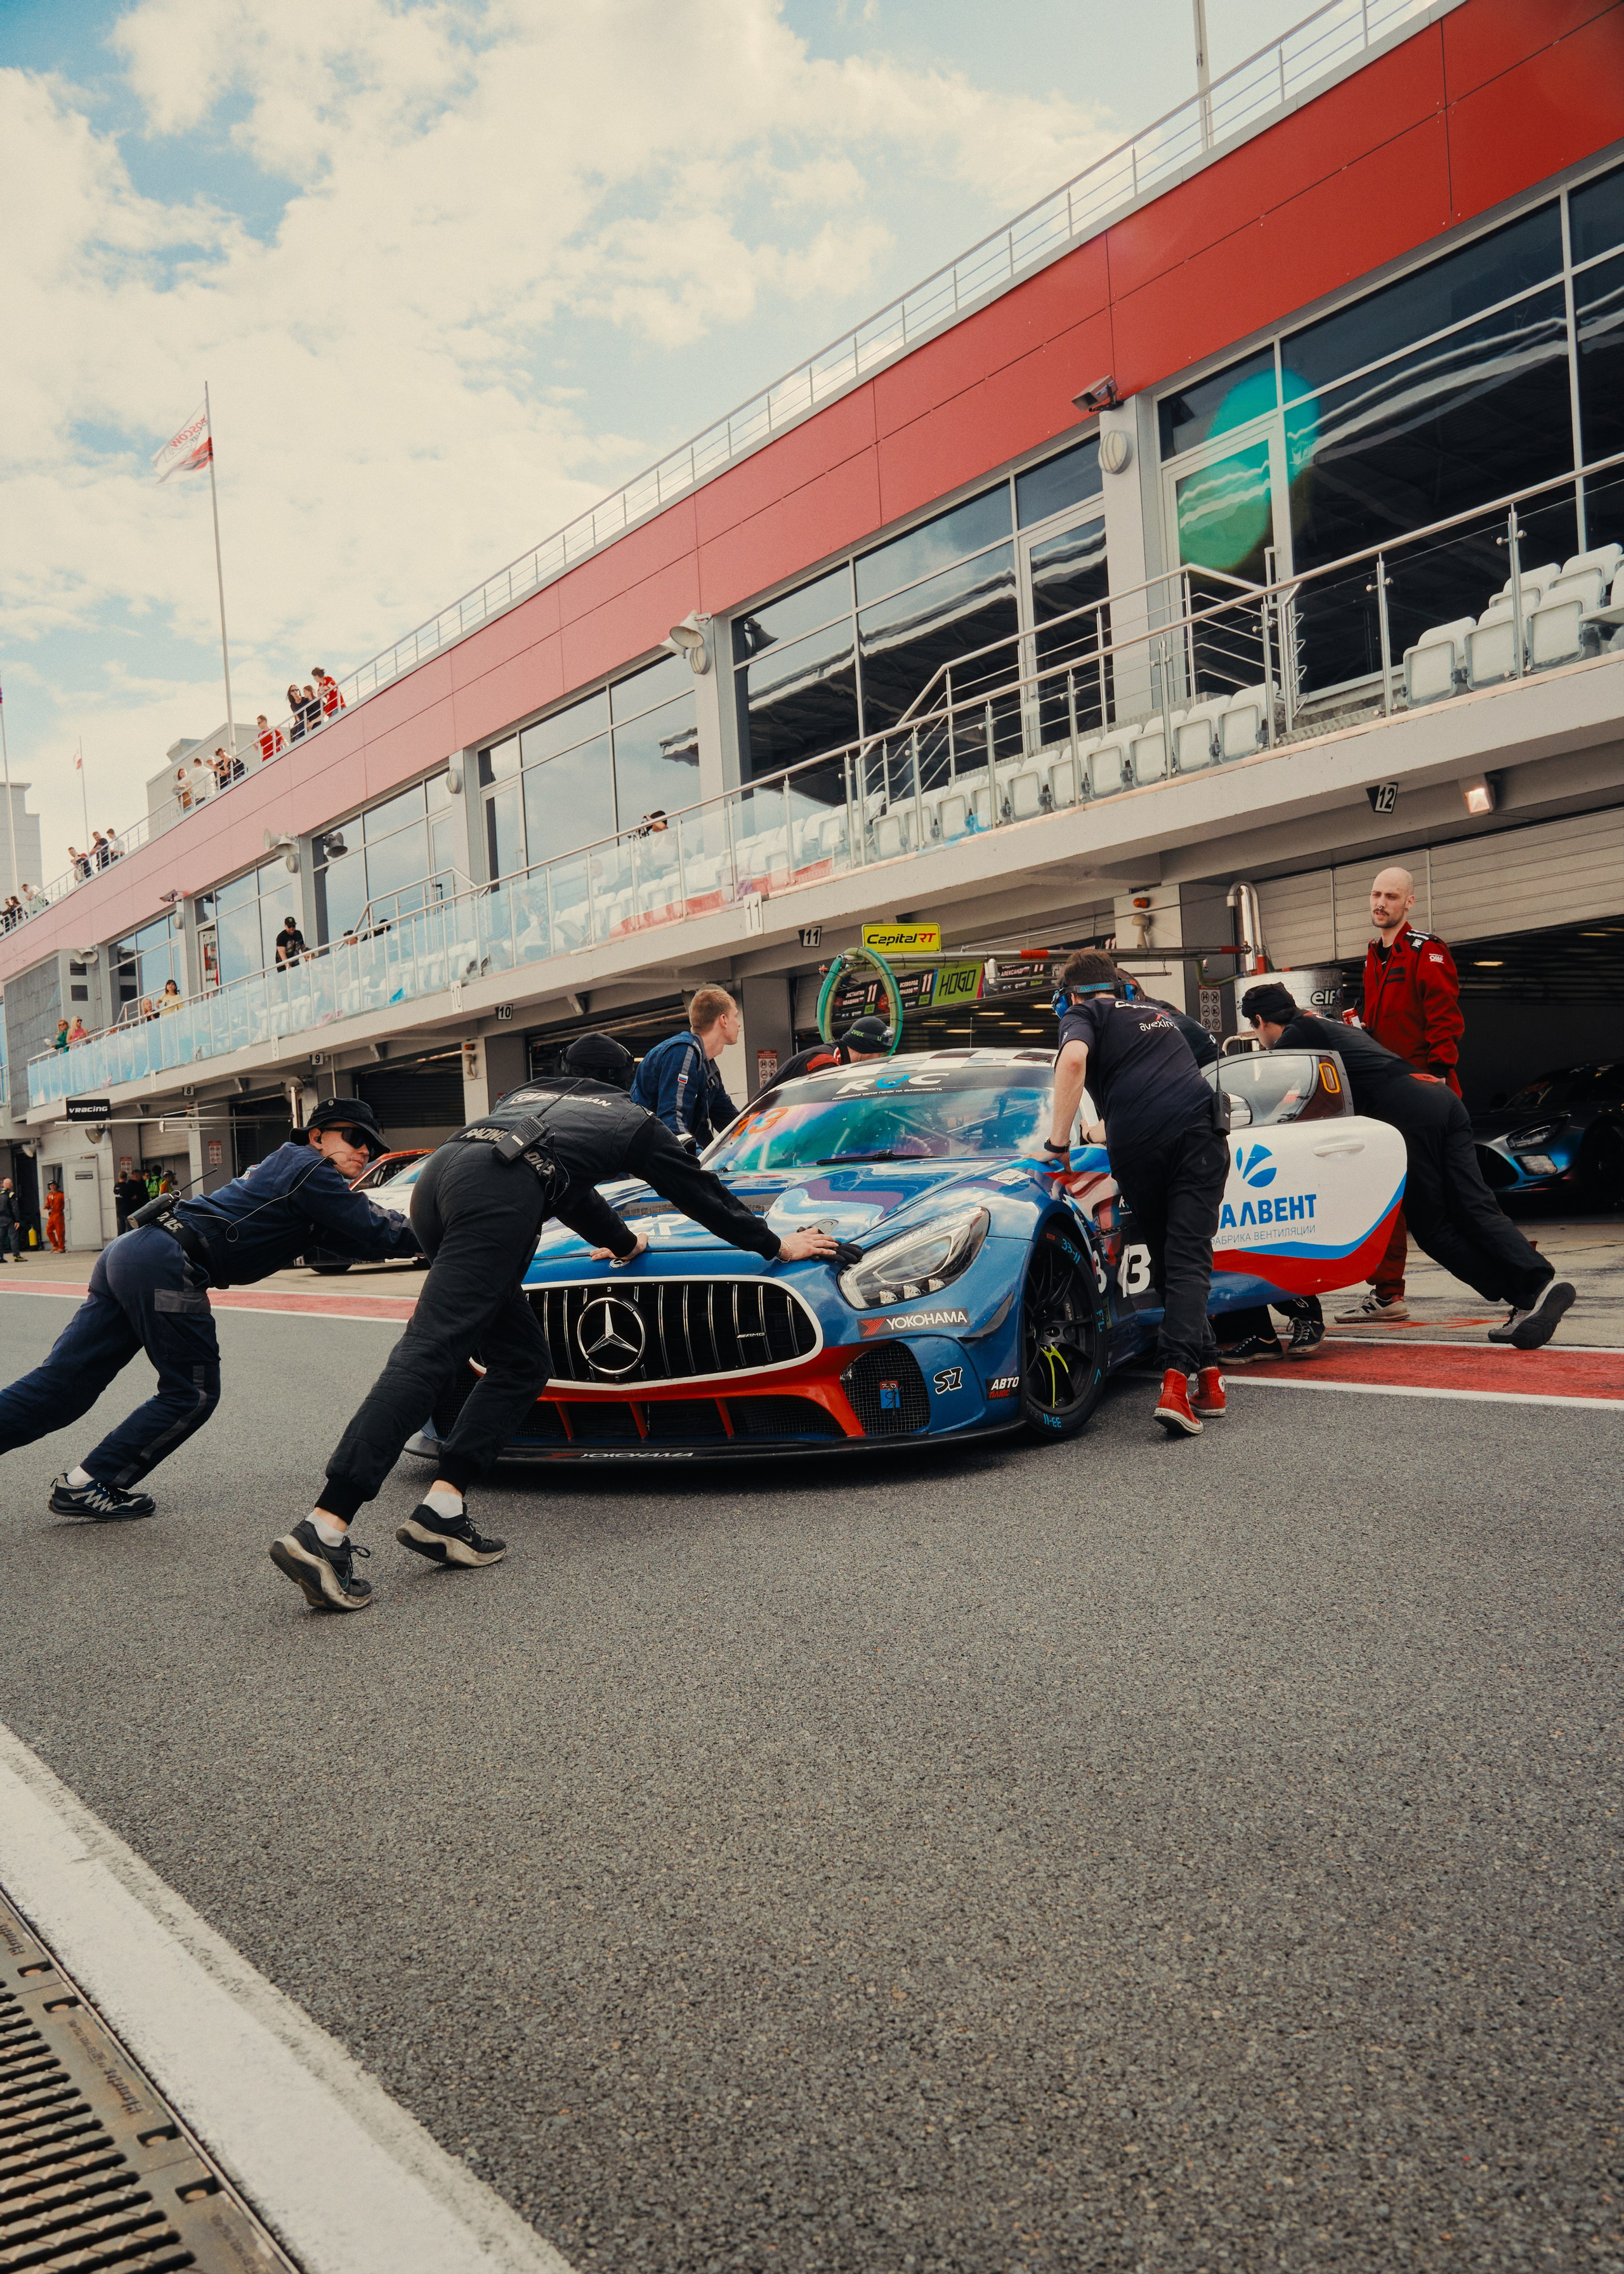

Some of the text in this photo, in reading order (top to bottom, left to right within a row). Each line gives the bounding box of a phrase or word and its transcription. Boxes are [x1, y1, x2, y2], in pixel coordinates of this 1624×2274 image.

[1379, 786, 1395, 809] 12
[747, 898, 760, 930] 11
[806, 929, 819, 945] 11
[922, 973, 933, 992] 11
[939, 969, 976, 996] HOGO
[867, 984, 877, 1002] 11
[1311, 990, 1335, 1005] elf
[499, 1006, 511, 1018] 10
[315, 1054, 320, 1063] 9
[730, 1107, 789, 1139] 13
[1220, 1194, 1316, 1229] АЛВЕНТ
[1254, 1225, 1315, 1240] ВЕНТИЛЯЦИИ
[886, 1311, 967, 1330] YOKOHAMA
[991, 1376, 1019, 1391] АВТО
